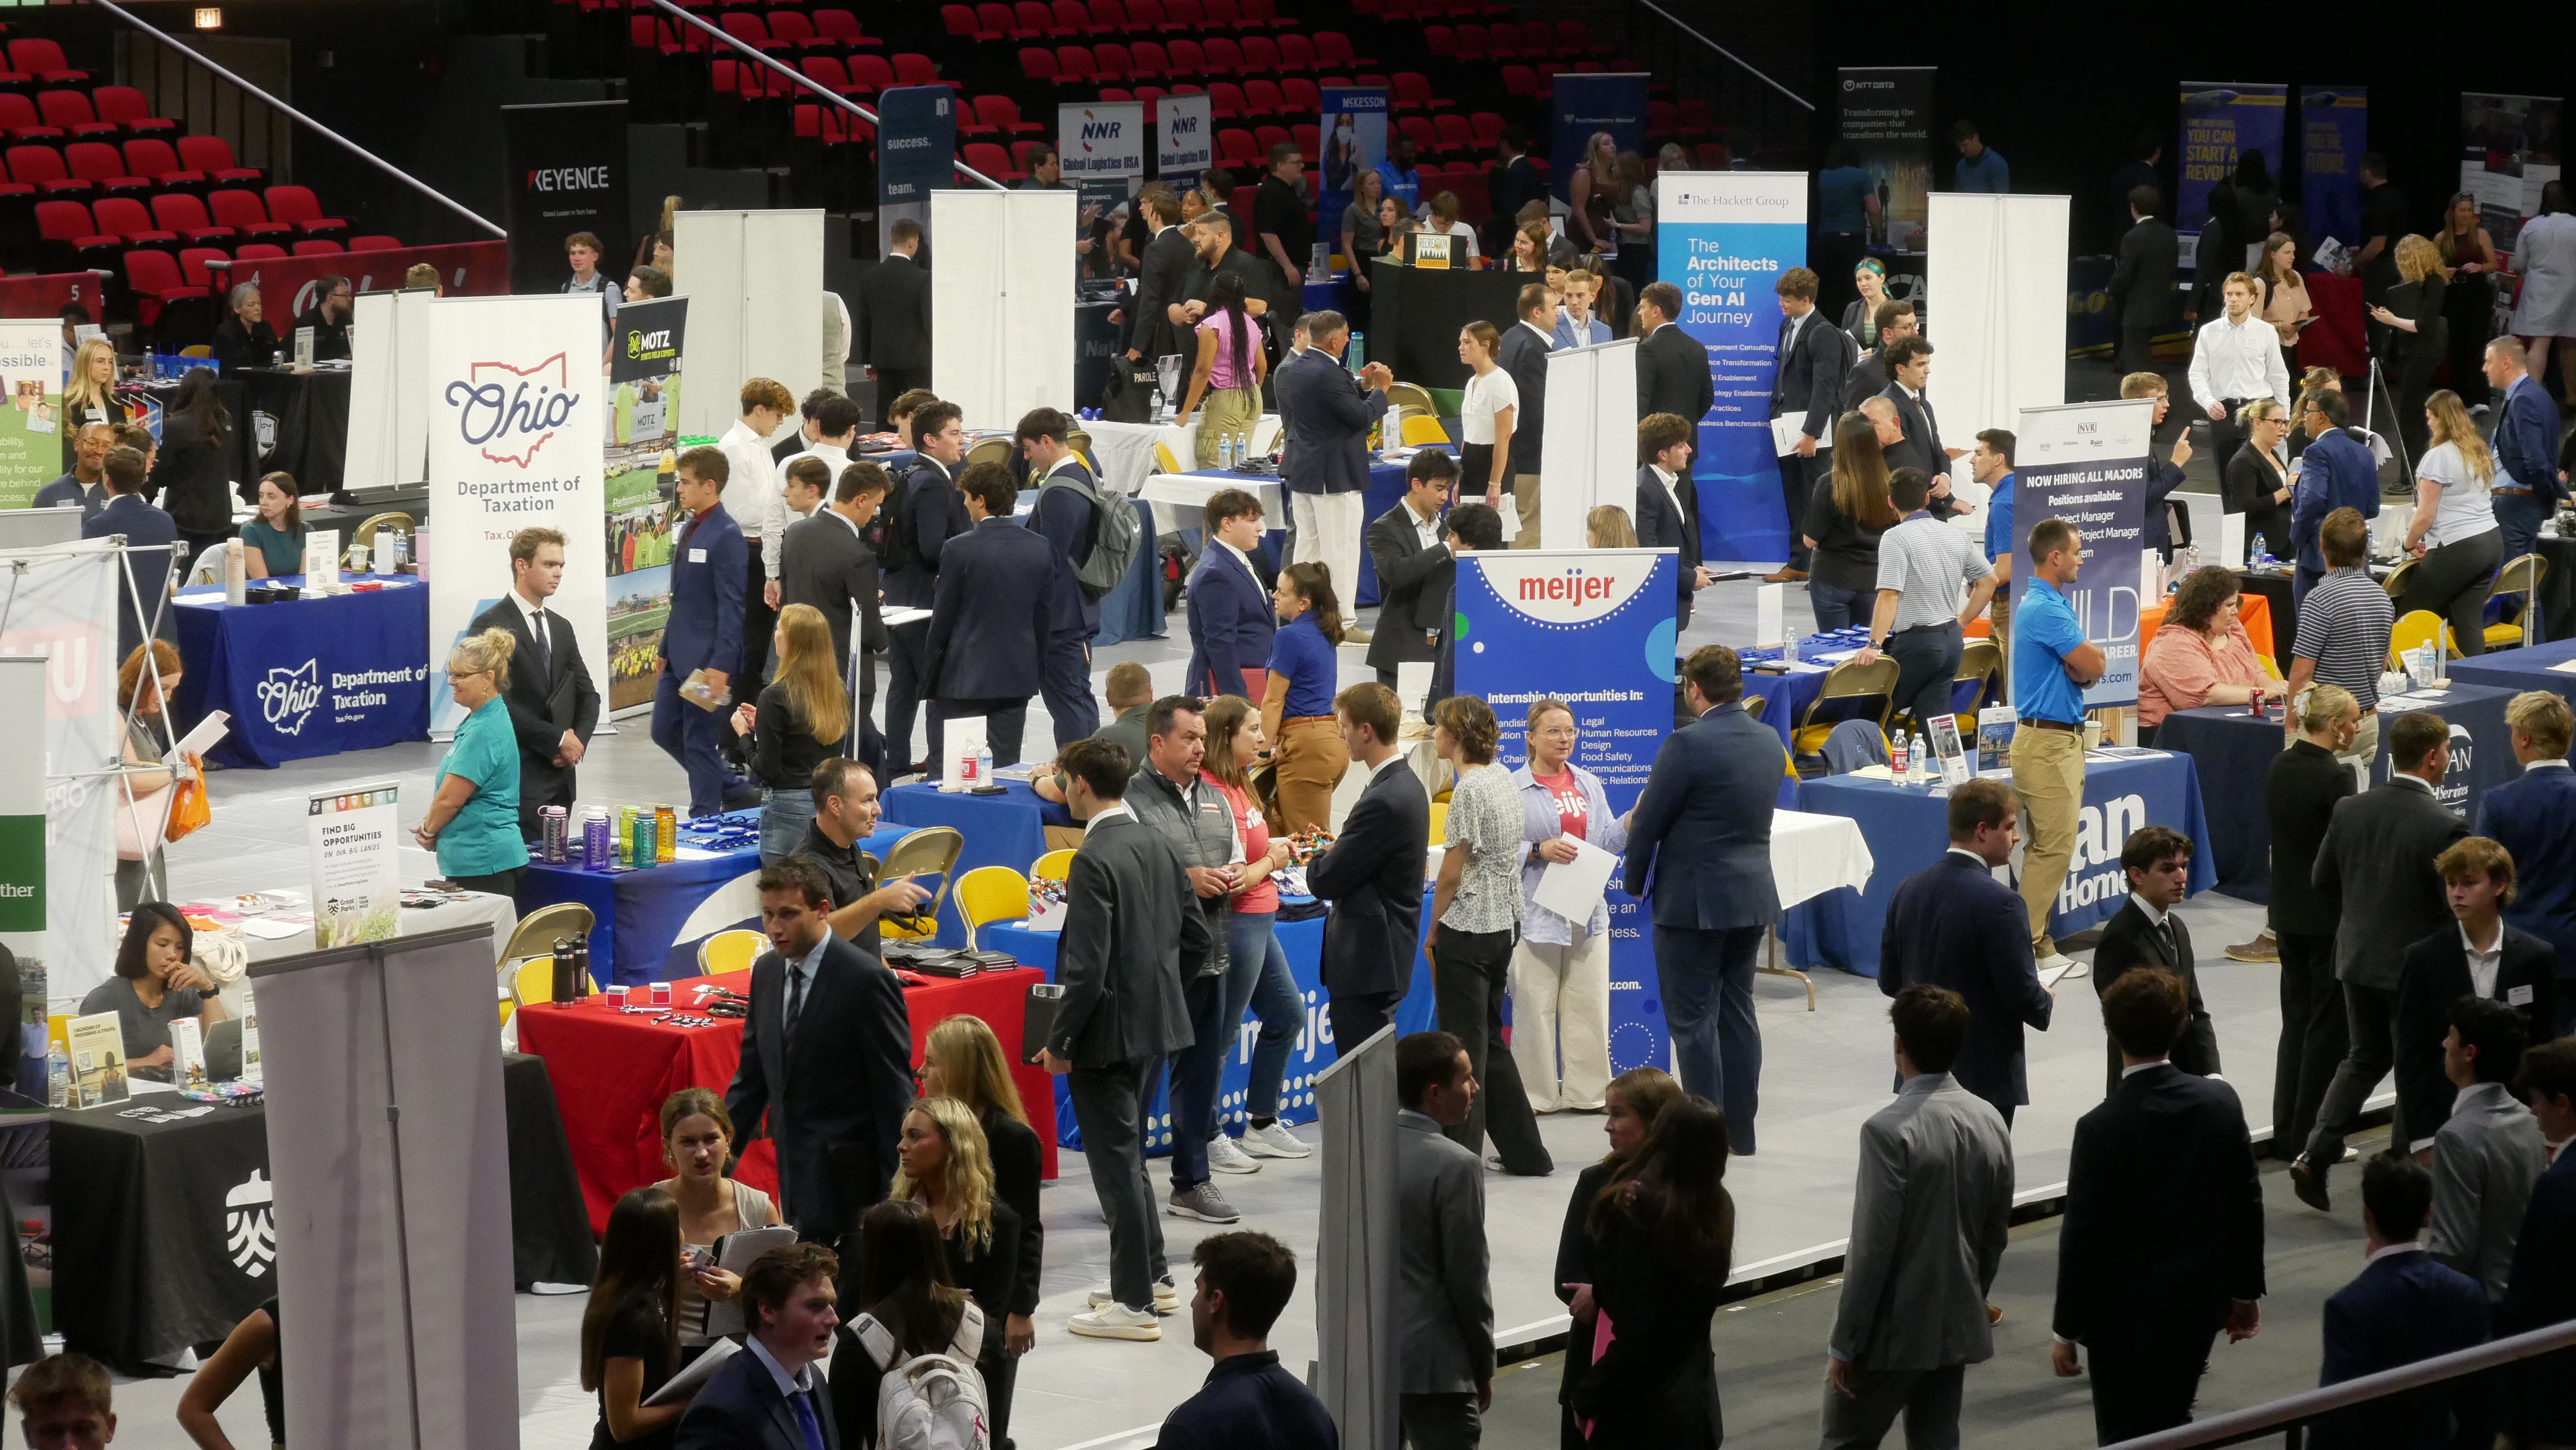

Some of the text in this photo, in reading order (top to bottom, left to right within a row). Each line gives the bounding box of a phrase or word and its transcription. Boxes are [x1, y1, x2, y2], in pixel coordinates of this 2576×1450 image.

[197, 10, 218, 26] EXIT
[1843, 108, 1900, 118] Transforming
[1081, 122, 1121, 140] NNR
[1171, 116, 1197, 135] NNR
[1843, 120, 1887, 129] companies
[2188, 129, 2235, 143] YOU CAN
[887, 137, 932, 150] success.
[1160, 149, 1209, 167] Global Logistics USA
[2186, 146, 2238, 162] START A
[1063, 156, 1139, 172] Global Logistics USA
[528, 166, 609, 191] KEYENCE
[888, 183, 916, 195] team.
[1691, 195, 1789, 208] The Hackett Group
[1419, 237, 1448, 250] RECREATION
[1687, 238, 1719, 253] The
[1687, 256, 1779, 271] Architects
[251, 270, 260, 286] 4
[1687, 273, 1746, 288] of Your
[71, 285, 79, 301] 5
[1687, 291, 1745, 306] Gen AI
[1687, 309, 1753, 327] Journey
[28, 337, 51, 348] let's
[641, 330, 670, 351] MOTZ
[641, 352, 651, 361] SPORTS
[661, 348, 675, 357] EXPERTS
[1739, 344, 1775, 352] Consulting
[0, 354, 46, 367] ssible
[1134, 372, 1157, 383] PAROLE
[445, 380, 580, 444] Ohio
[637, 414, 655, 426] MOTZ
[1724, 420, 1772, 429] Benchmarking
[2079, 423, 2096, 432] NVR
[0, 438, 24, 447] bility,
[8, 451, 26, 460] and
[15, 465, 27, 473] for
[9, 479, 40, 487] behind
[2026, 467, 2143, 488] NOW HIRING ALL MAJORS
[458, 476, 581, 498] Department of
[482, 495, 554, 512] Taxation
[613, 494, 642, 508] Performance
[647, 489, 661, 499] Built
[2048, 490, 2123, 506] Positions available:
[2081, 511, 2115, 523] Manager
[2078, 527, 2140, 542] Project Manager
[1520, 568, 1615, 607] meijer
[2103, 644, 2138, 659] AREER.
[332, 663, 429, 690] Department of
[2097, 672, 2132, 685] rs.com
[257, 679, 323, 723] Ohio
[332, 690, 387, 710] Taxation
[1488, 689, 1644, 704] Internship Opportunities In:
[1581, 717, 1604, 728] Legal
[1499, 731, 1522, 740] ation
[1581, 728, 1658, 737] Human Resources
[1581, 741, 1611, 751] Design
[1502, 754, 1527, 764] Chain
[1581, 752, 1633, 763] Food Safety
[1581, 764, 1652, 773] Communications
[1609, 774, 1649, 785] Relations
[1553, 790, 1588, 818] eije
[322, 823, 356, 836] FIND BIG
[323, 831, 382, 847] OPPORTUNITIES
[336, 848, 347, 857] OUR
[349, 846, 358, 855] BIG
[361, 843, 380, 852] LANDS
[0, 883, 35, 897] ther
[2059, 869, 2129, 915] Home
[1621, 903, 1636, 914] an
[1609, 928, 1641, 938] ness.
[1609, 981, 1642, 991] r.com.
[73, 1025, 95, 1034] CALENDAR
[73, 1029, 97, 1039] PROGRAMS
